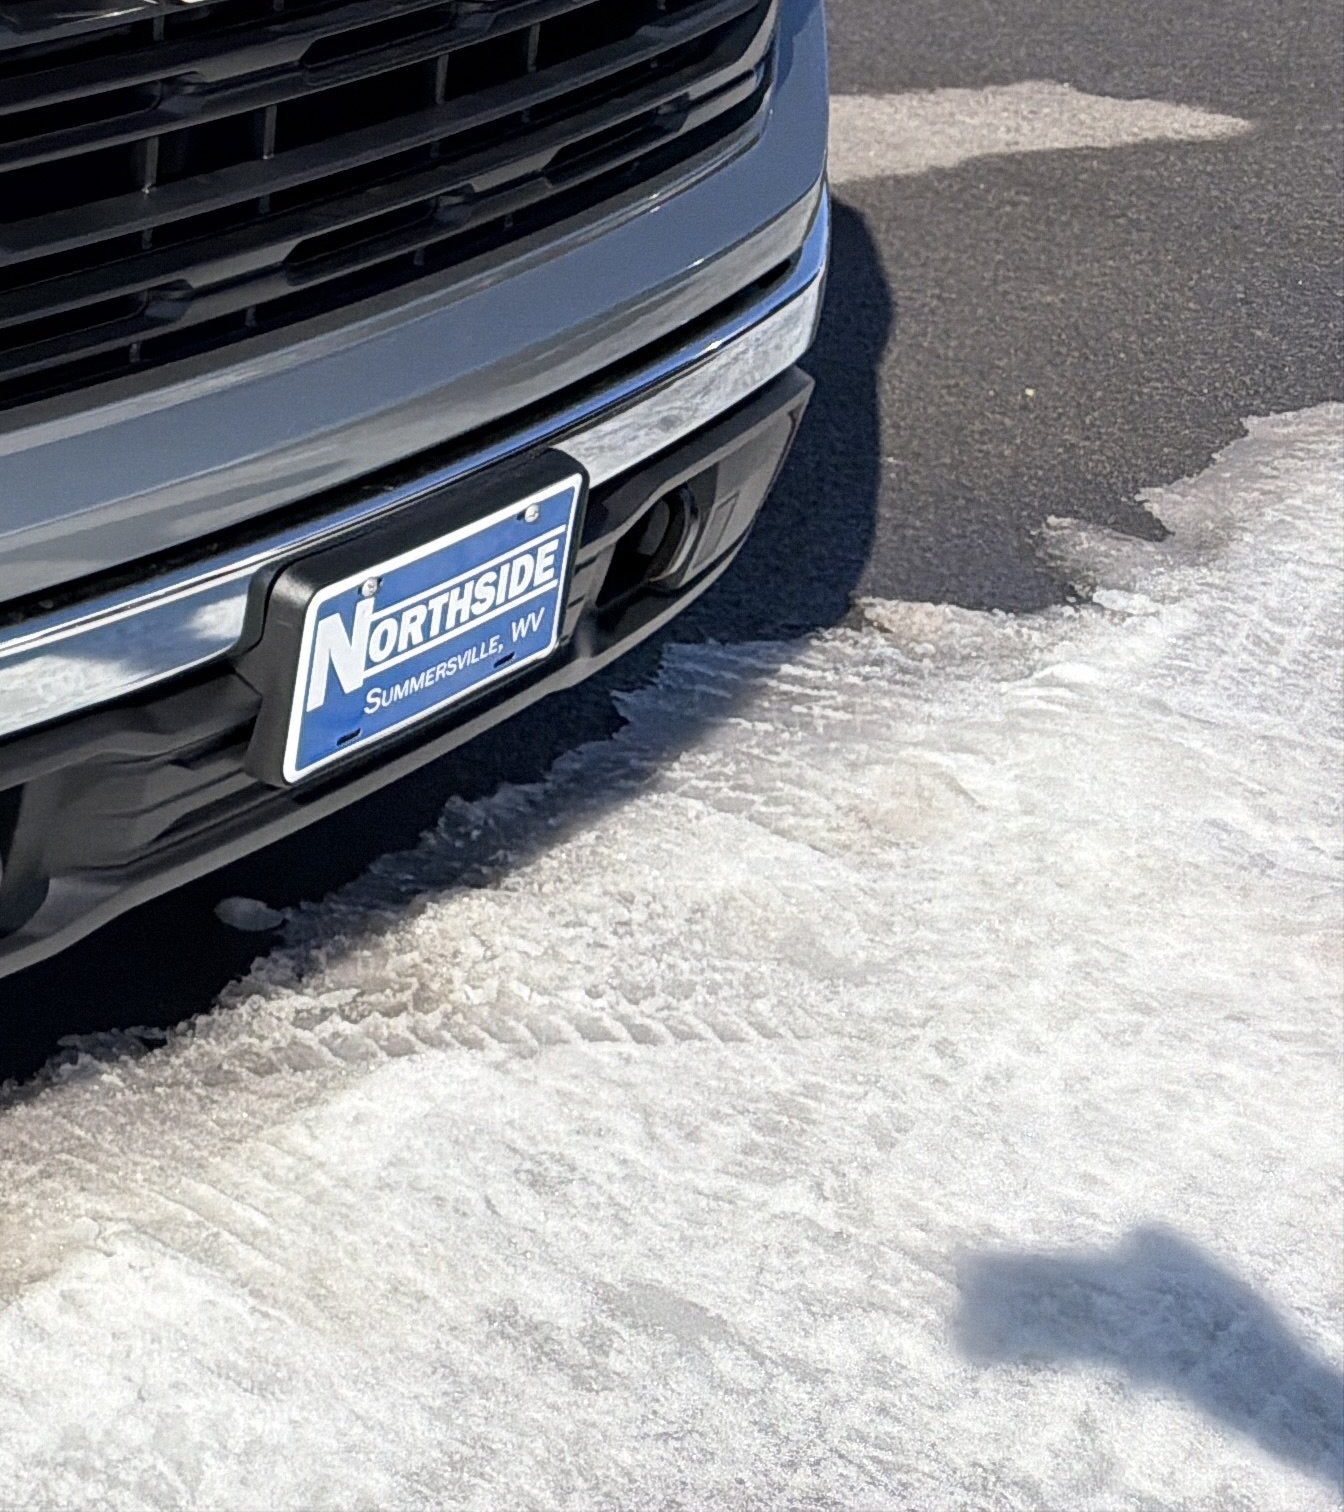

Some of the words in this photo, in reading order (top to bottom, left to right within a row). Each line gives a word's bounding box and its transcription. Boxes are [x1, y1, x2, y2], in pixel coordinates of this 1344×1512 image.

[307, 538, 560, 713] NORTHSIDE
[363, 635, 504, 715] SUMMERSVILLE,
[511, 607, 545, 643] WV
